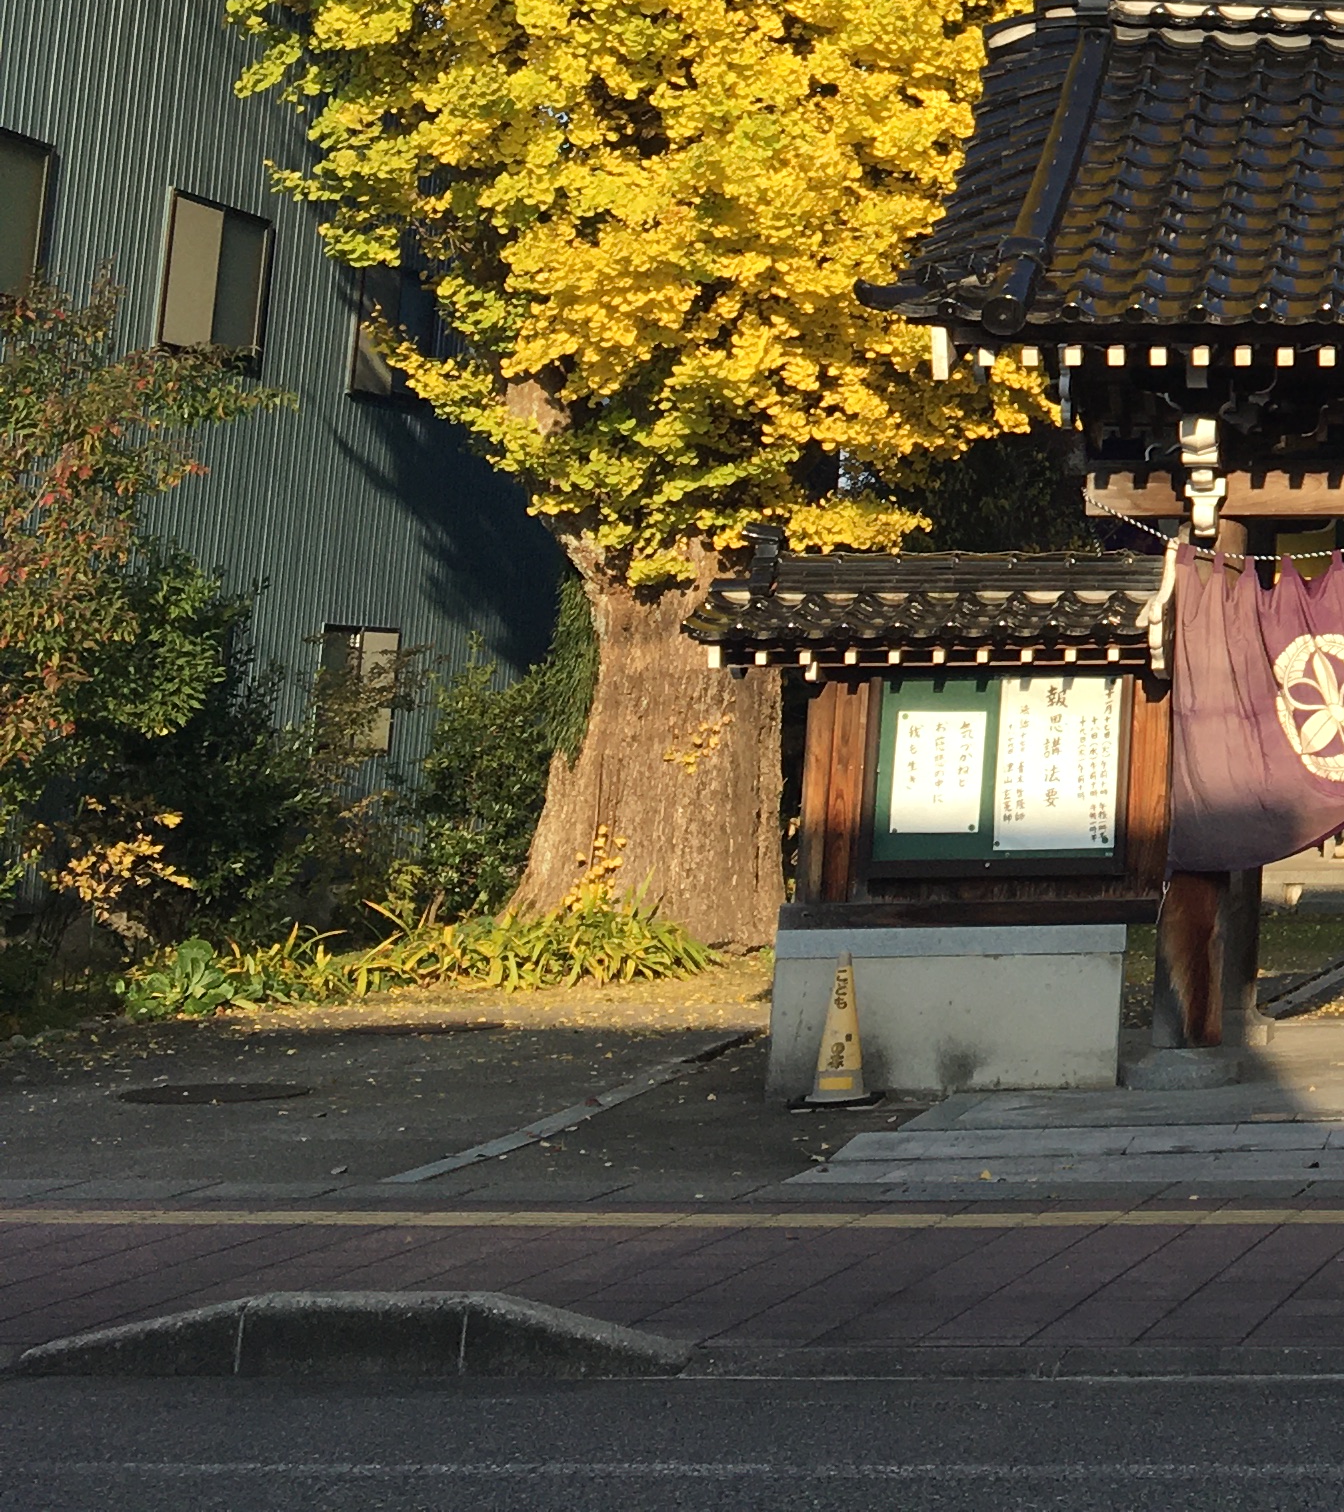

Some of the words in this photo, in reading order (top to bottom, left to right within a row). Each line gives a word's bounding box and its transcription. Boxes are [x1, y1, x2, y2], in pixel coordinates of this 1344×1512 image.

[1043, 685, 1068, 808] 報恩講法要
